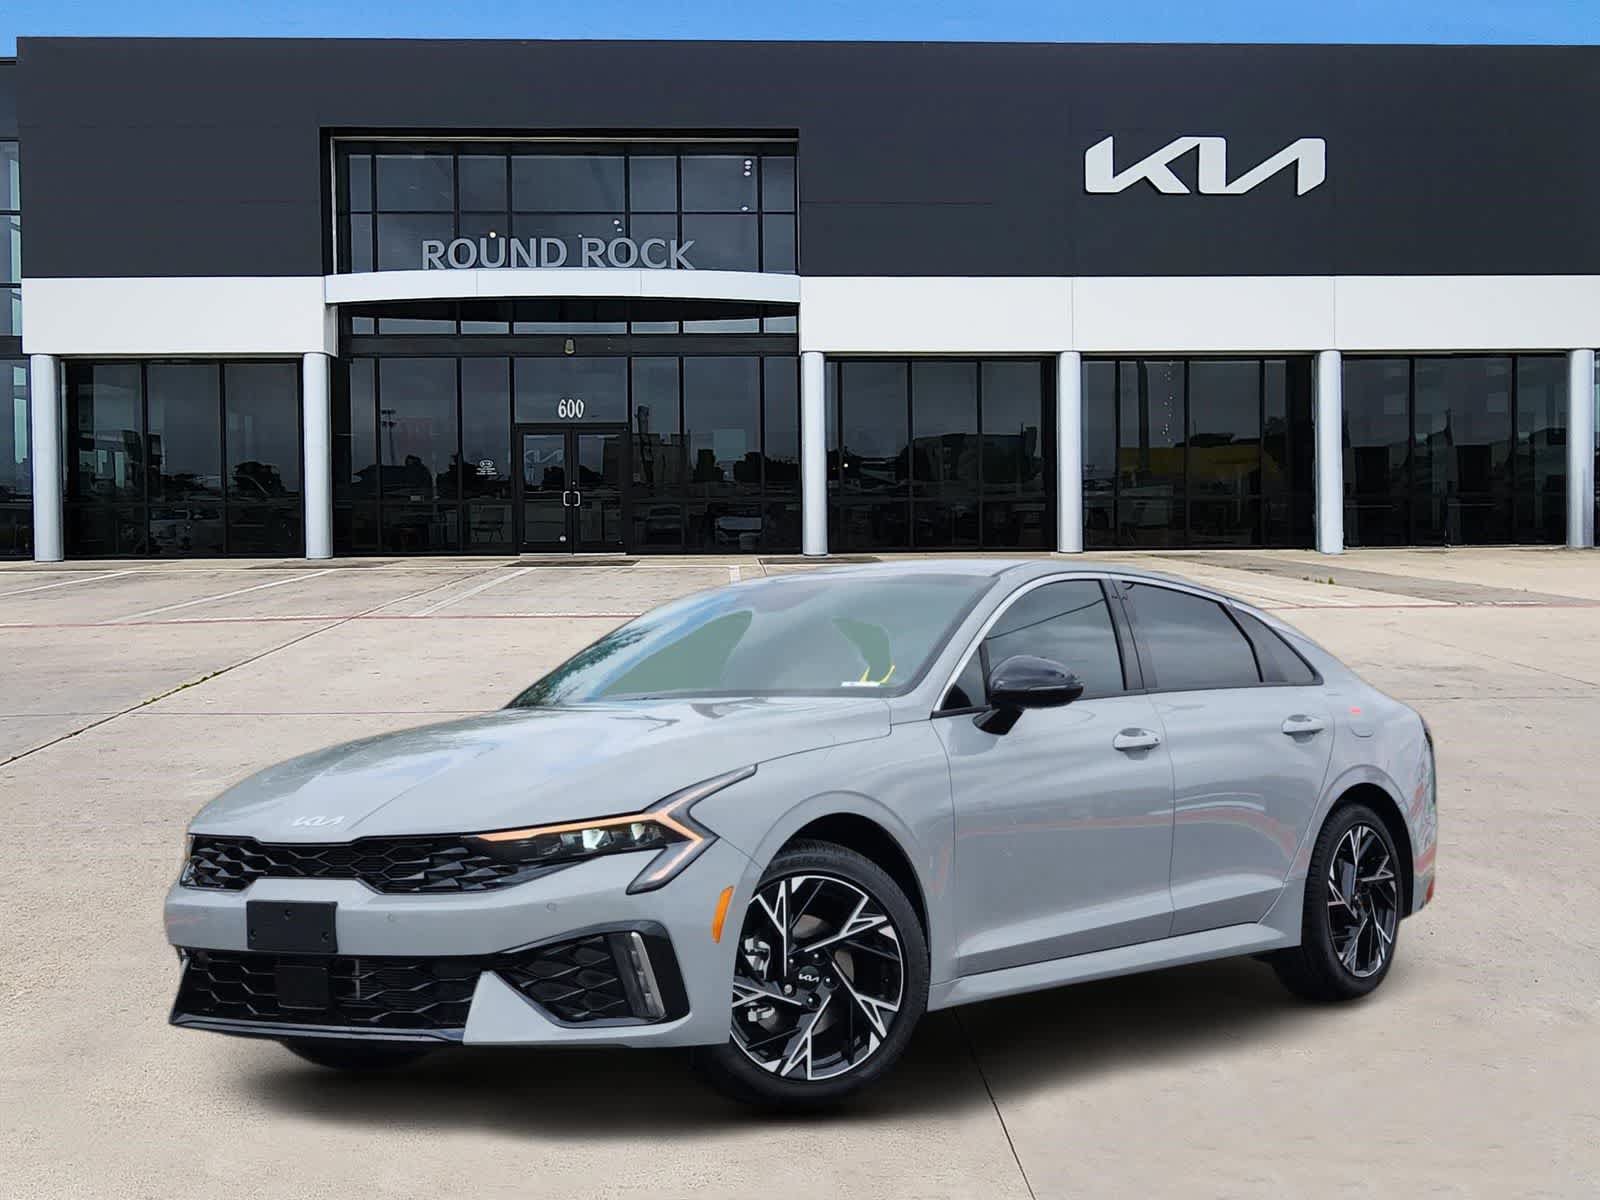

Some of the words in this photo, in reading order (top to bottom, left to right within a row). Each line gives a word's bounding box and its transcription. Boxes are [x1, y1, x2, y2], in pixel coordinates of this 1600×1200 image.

[1085, 136, 1325, 195] KIA
[422, 237, 568, 270] ROUND
[582, 237, 696, 270] ROCK
[558, 399, 584, 418] 600
[292, 815, 345, 826] KIA
[799, 973, 820, 983] KIA
